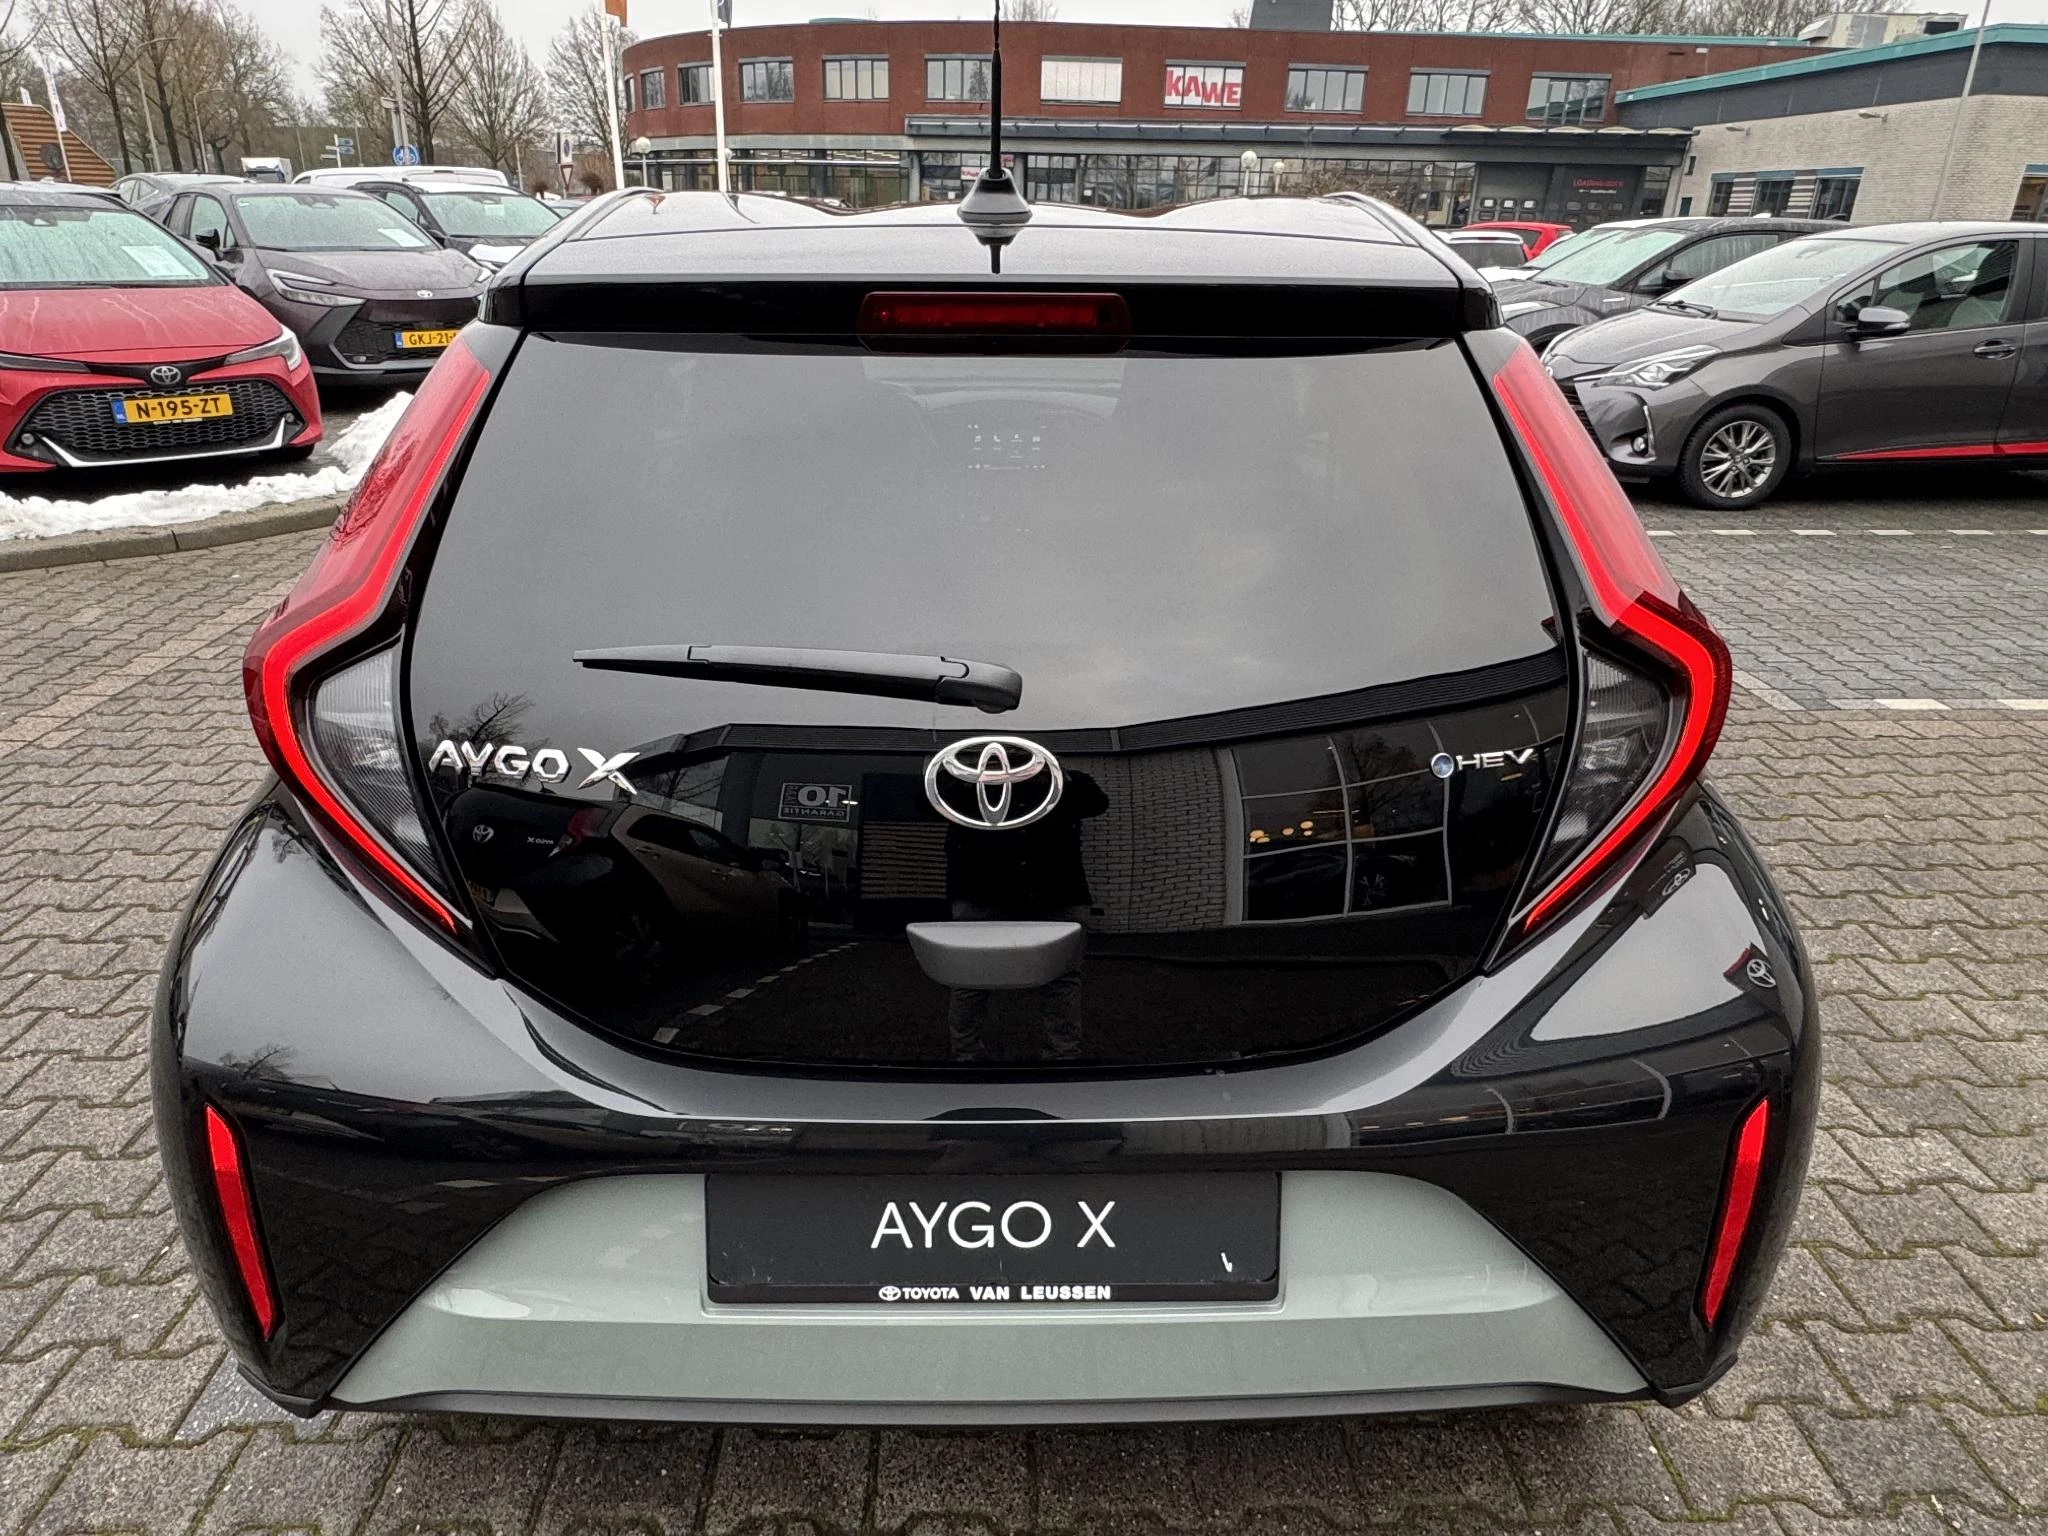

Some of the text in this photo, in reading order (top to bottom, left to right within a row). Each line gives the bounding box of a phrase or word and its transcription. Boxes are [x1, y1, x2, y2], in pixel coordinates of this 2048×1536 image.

[1165, 69, 1241, 104] KAWE
[136, 398, 220, 418] N-195-ZT
[428, 740, 641, 795] AYGO X
[1456, 748, 1534, 771] HEV
[870, 1200, 1116, 1249] AYGO X
[901, 1285, 1111, 1300] TOYOTA VAN LEUSSEN
